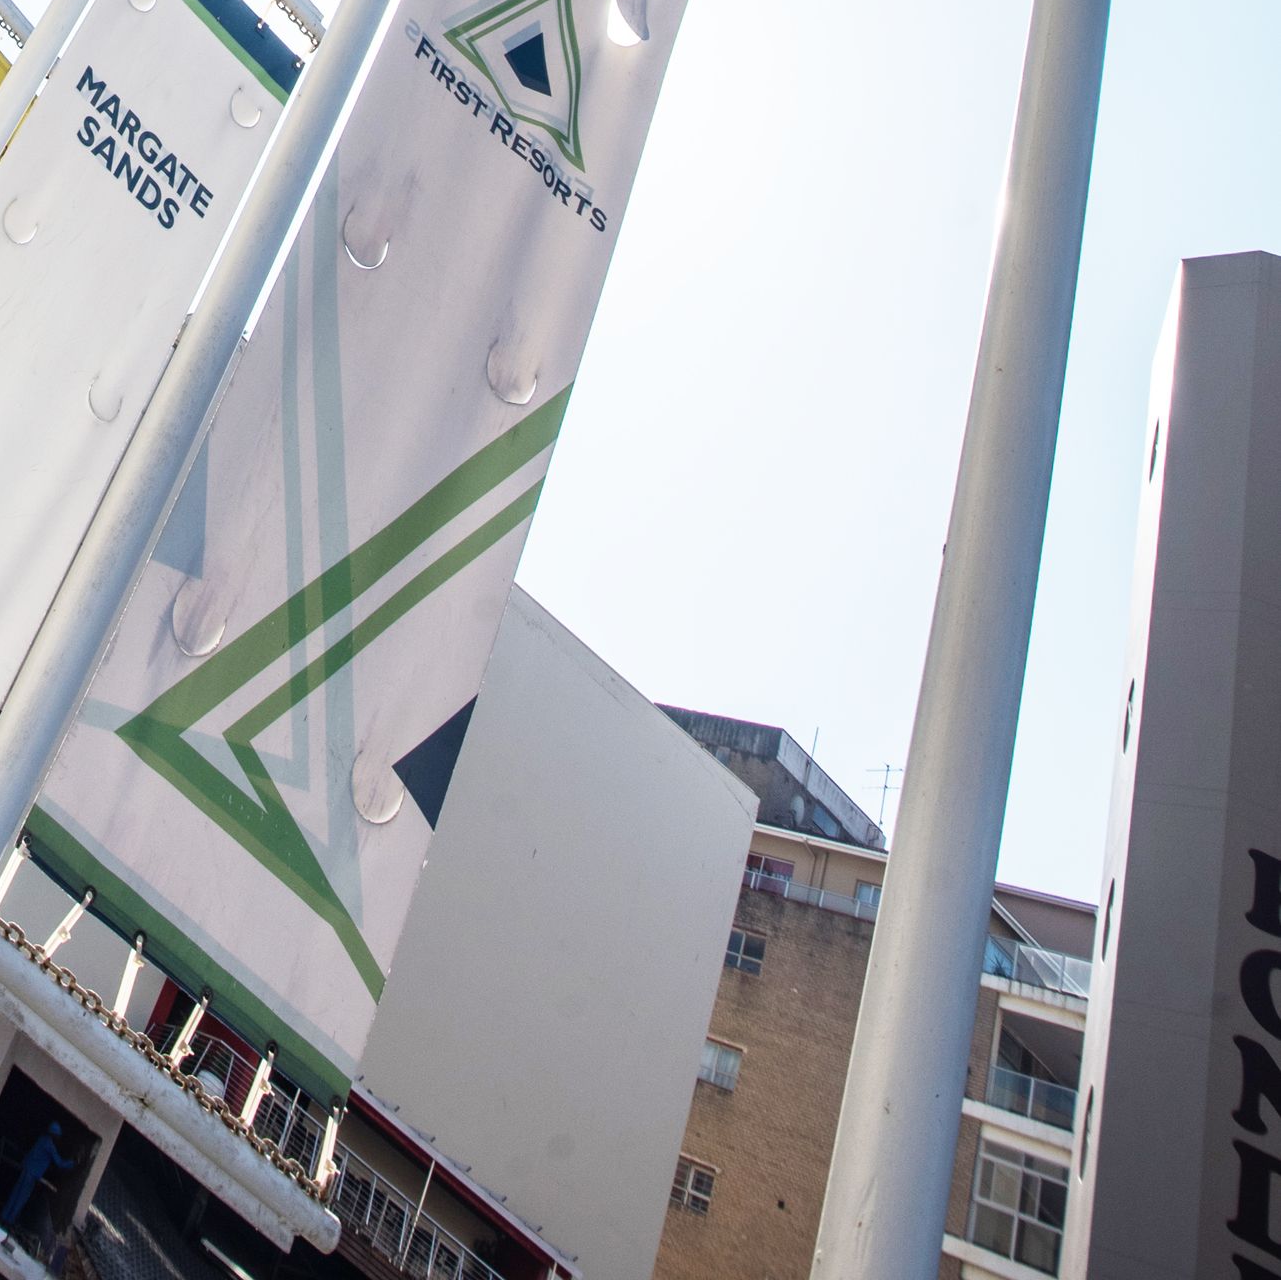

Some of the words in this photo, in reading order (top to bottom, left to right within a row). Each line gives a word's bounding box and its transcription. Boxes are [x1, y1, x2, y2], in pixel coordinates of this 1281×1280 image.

[76, 65, 213, 220] MARGATE
[76, 117, 180, 231] SANDS
[414, 36, 487, 117] FIRST
[490, 112, 608, 233] RESORTS
